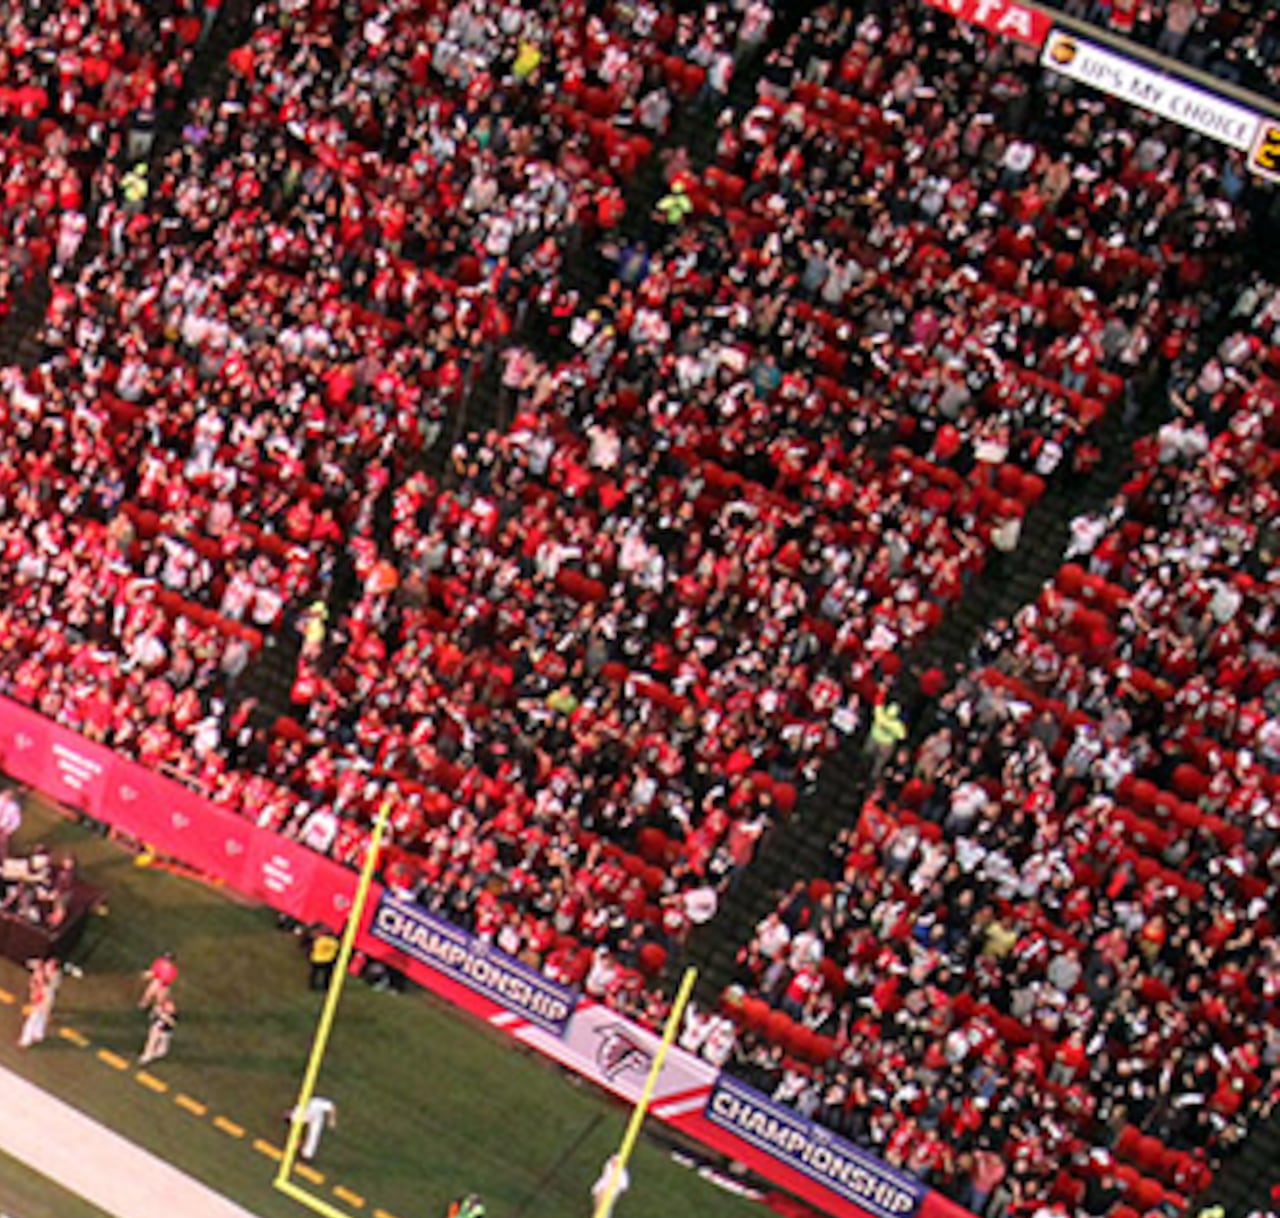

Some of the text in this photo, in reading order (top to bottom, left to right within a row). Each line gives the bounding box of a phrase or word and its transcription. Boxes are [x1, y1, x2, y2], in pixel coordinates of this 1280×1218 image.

[1129, 76, 1164, 103] MY
[1169, 95, 1250, 143] CHOICE
[377, 906, 568, 1020] CHAMPIONSHIP
[711, 1092, 914, 1213] CHAMPIONSHIP
